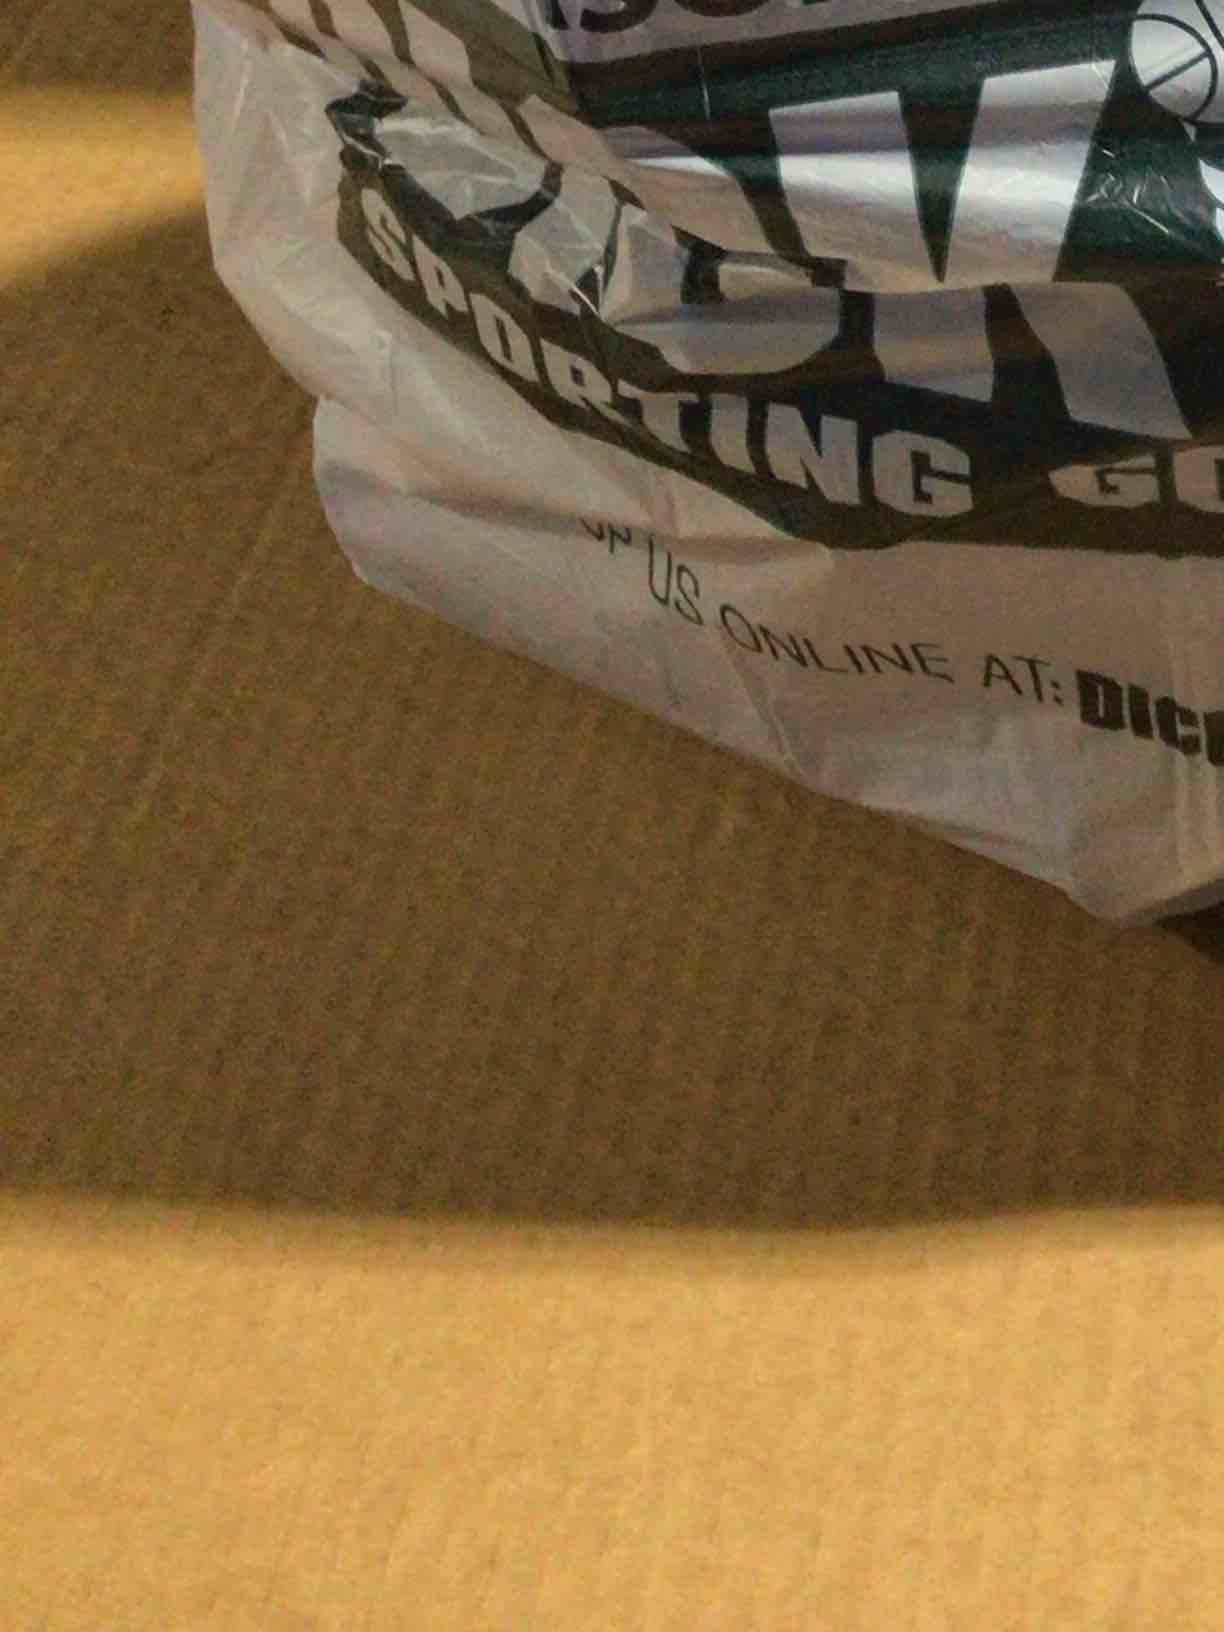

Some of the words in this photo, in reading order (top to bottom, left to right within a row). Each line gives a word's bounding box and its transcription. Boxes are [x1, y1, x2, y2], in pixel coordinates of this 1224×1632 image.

[361, 185, 975, 518] SPORTING
[647, 534, 704, 627] US
[718, 602, 956, 684] ONLINE
[982, 653, 1065, 706] AT:
